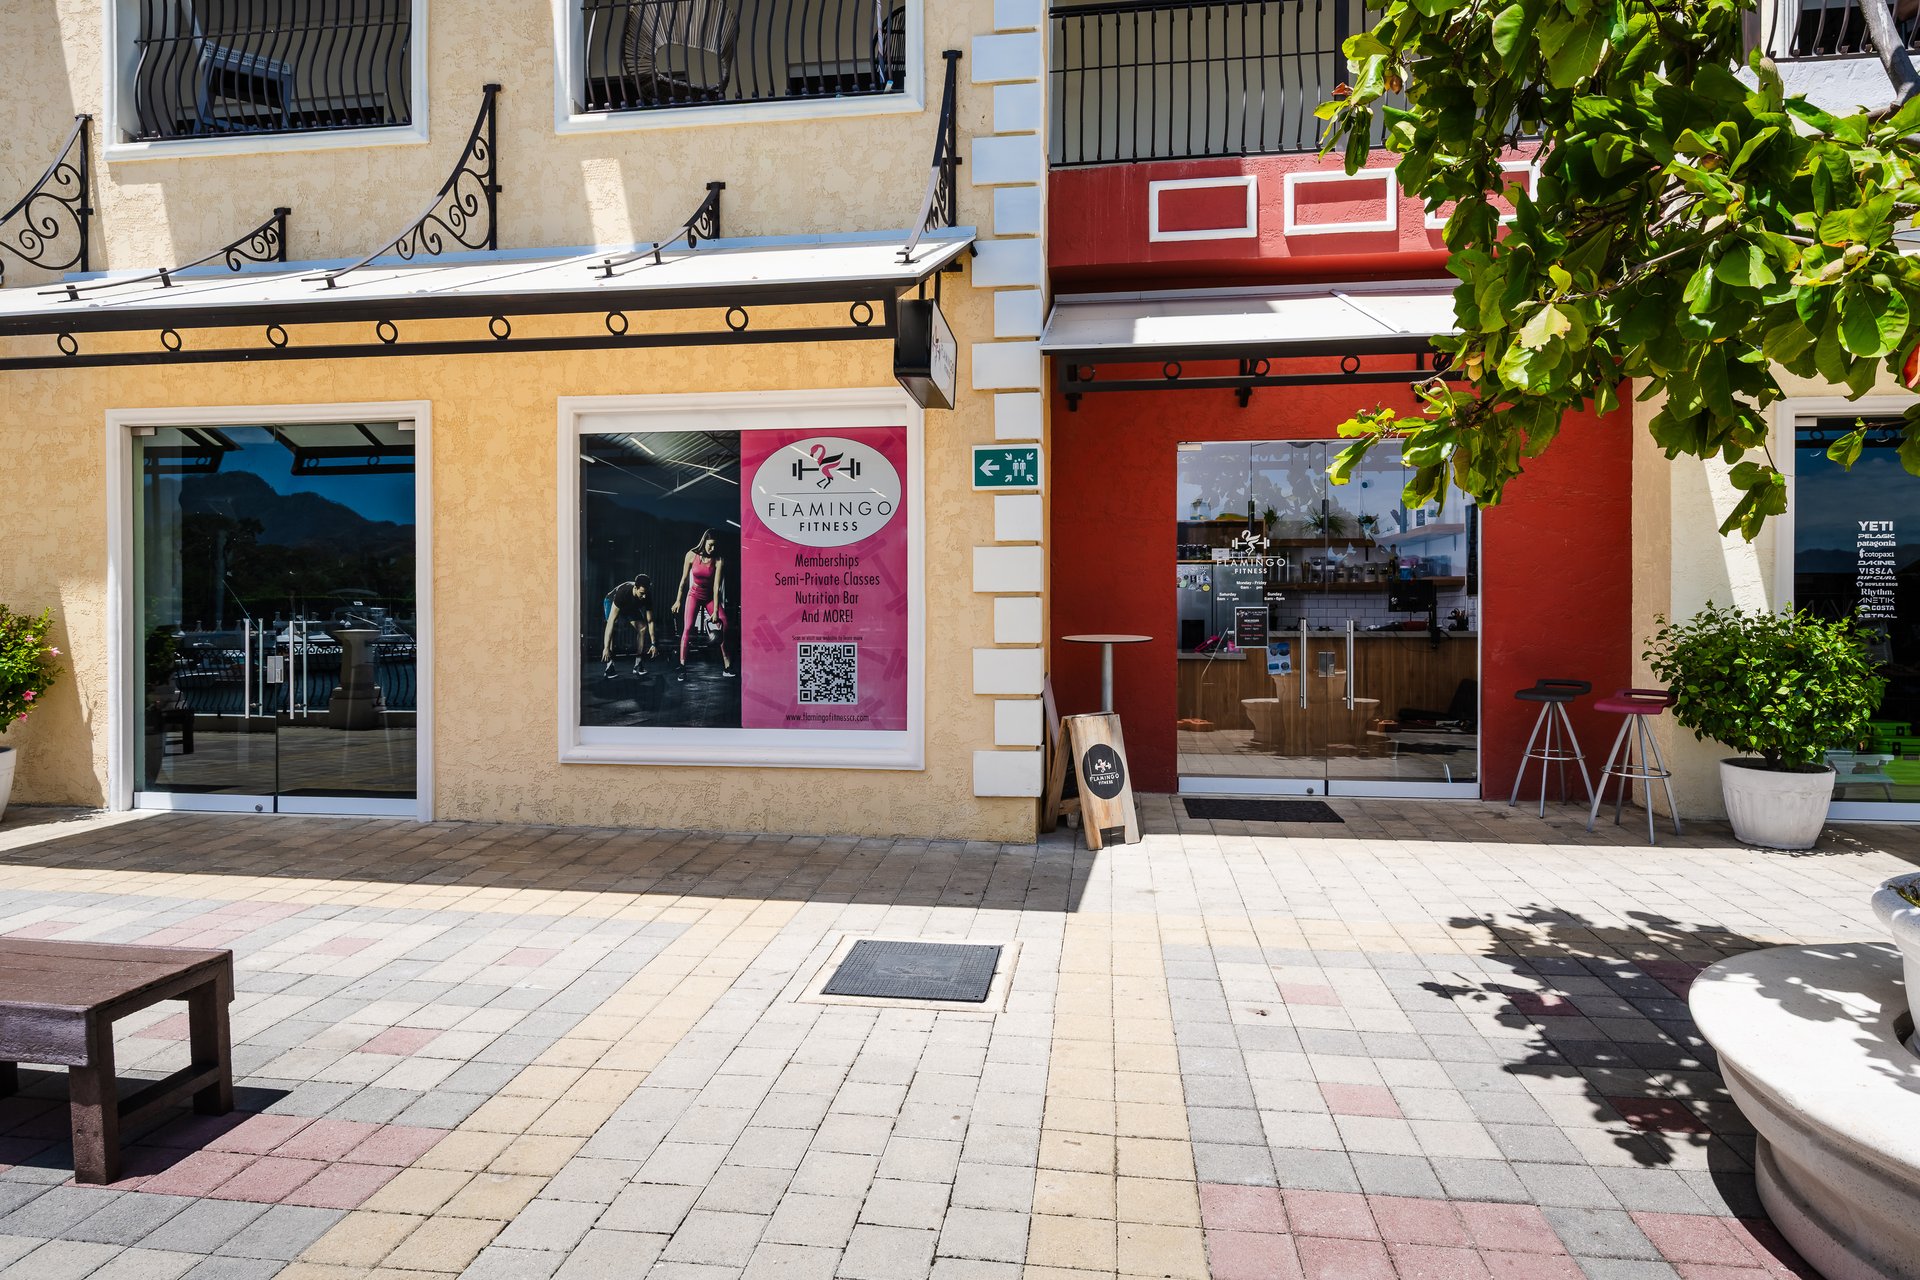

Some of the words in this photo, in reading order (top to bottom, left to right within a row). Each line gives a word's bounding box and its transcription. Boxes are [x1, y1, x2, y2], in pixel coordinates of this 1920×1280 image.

[768, 501, 892, 517] FLAMINGO
[800, 521, 858, 532] FITNESS
[1858, 521, 1894, 531] YETI
[795, 553, 859, 569] Memberships
[1216, 558, 1286, 567] FLAMINGO
[774, 572, 840, 586] Semi-Private
[843, 572, 880, 586] Classes
[795, 591, 840, 604] Nutrition
[843, 591, 859, 604] Bar
[1861, 588, 1895, 597] Rhythm.
[801, 610, 819, 623] And
[823, 610, 853, 623] MORE!
[786, 712, 869, 723] www.flamingofitnesscr.com
[1090, 773, 1119, 782] FLAMINGO
